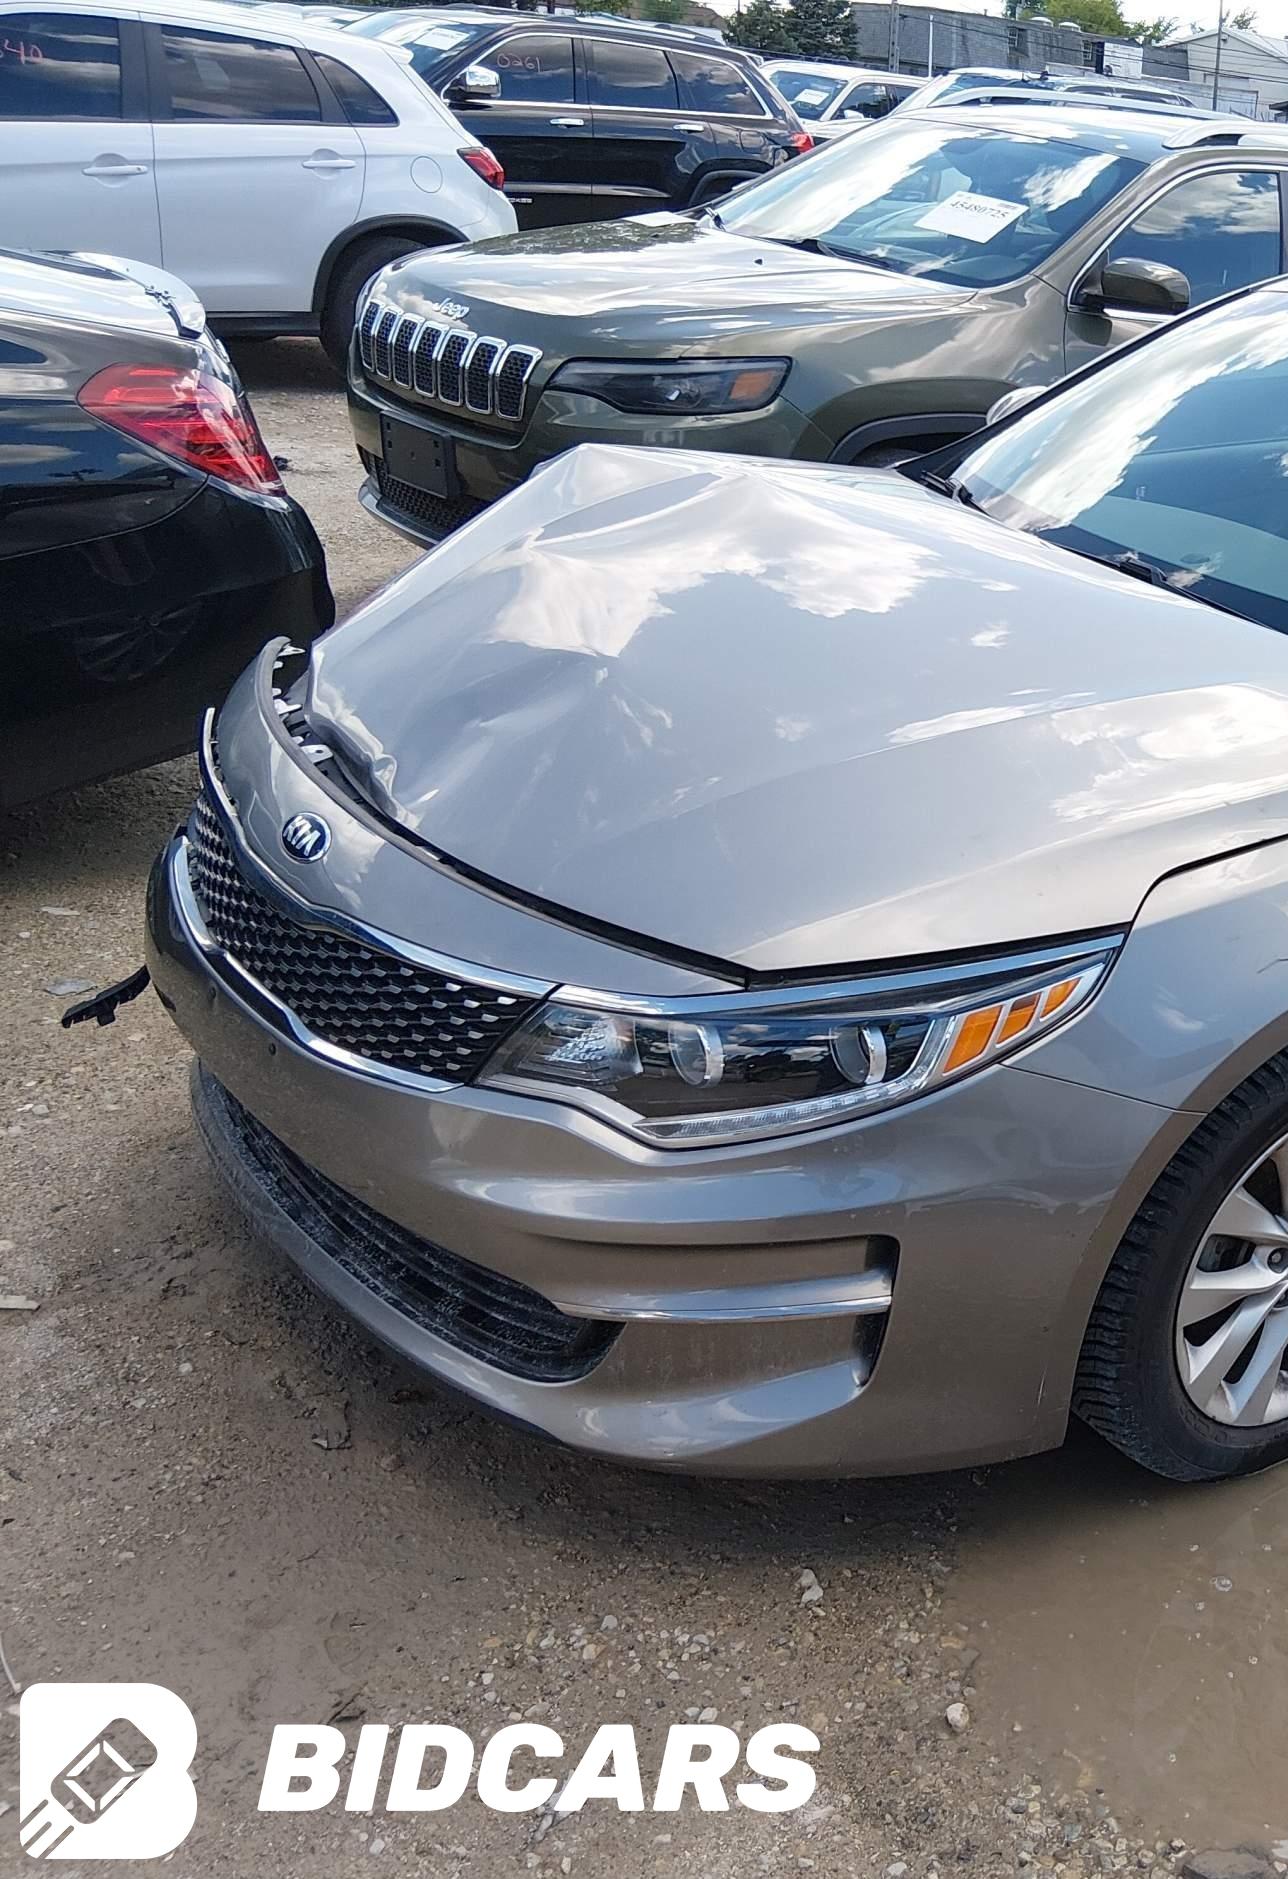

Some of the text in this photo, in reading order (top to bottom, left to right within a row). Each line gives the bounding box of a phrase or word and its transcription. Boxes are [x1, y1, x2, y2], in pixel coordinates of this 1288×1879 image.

[0, 39, 44, 64] 40
[432, 297, 470, 320] Jeep
[283, 815, 321, 856] KIA
